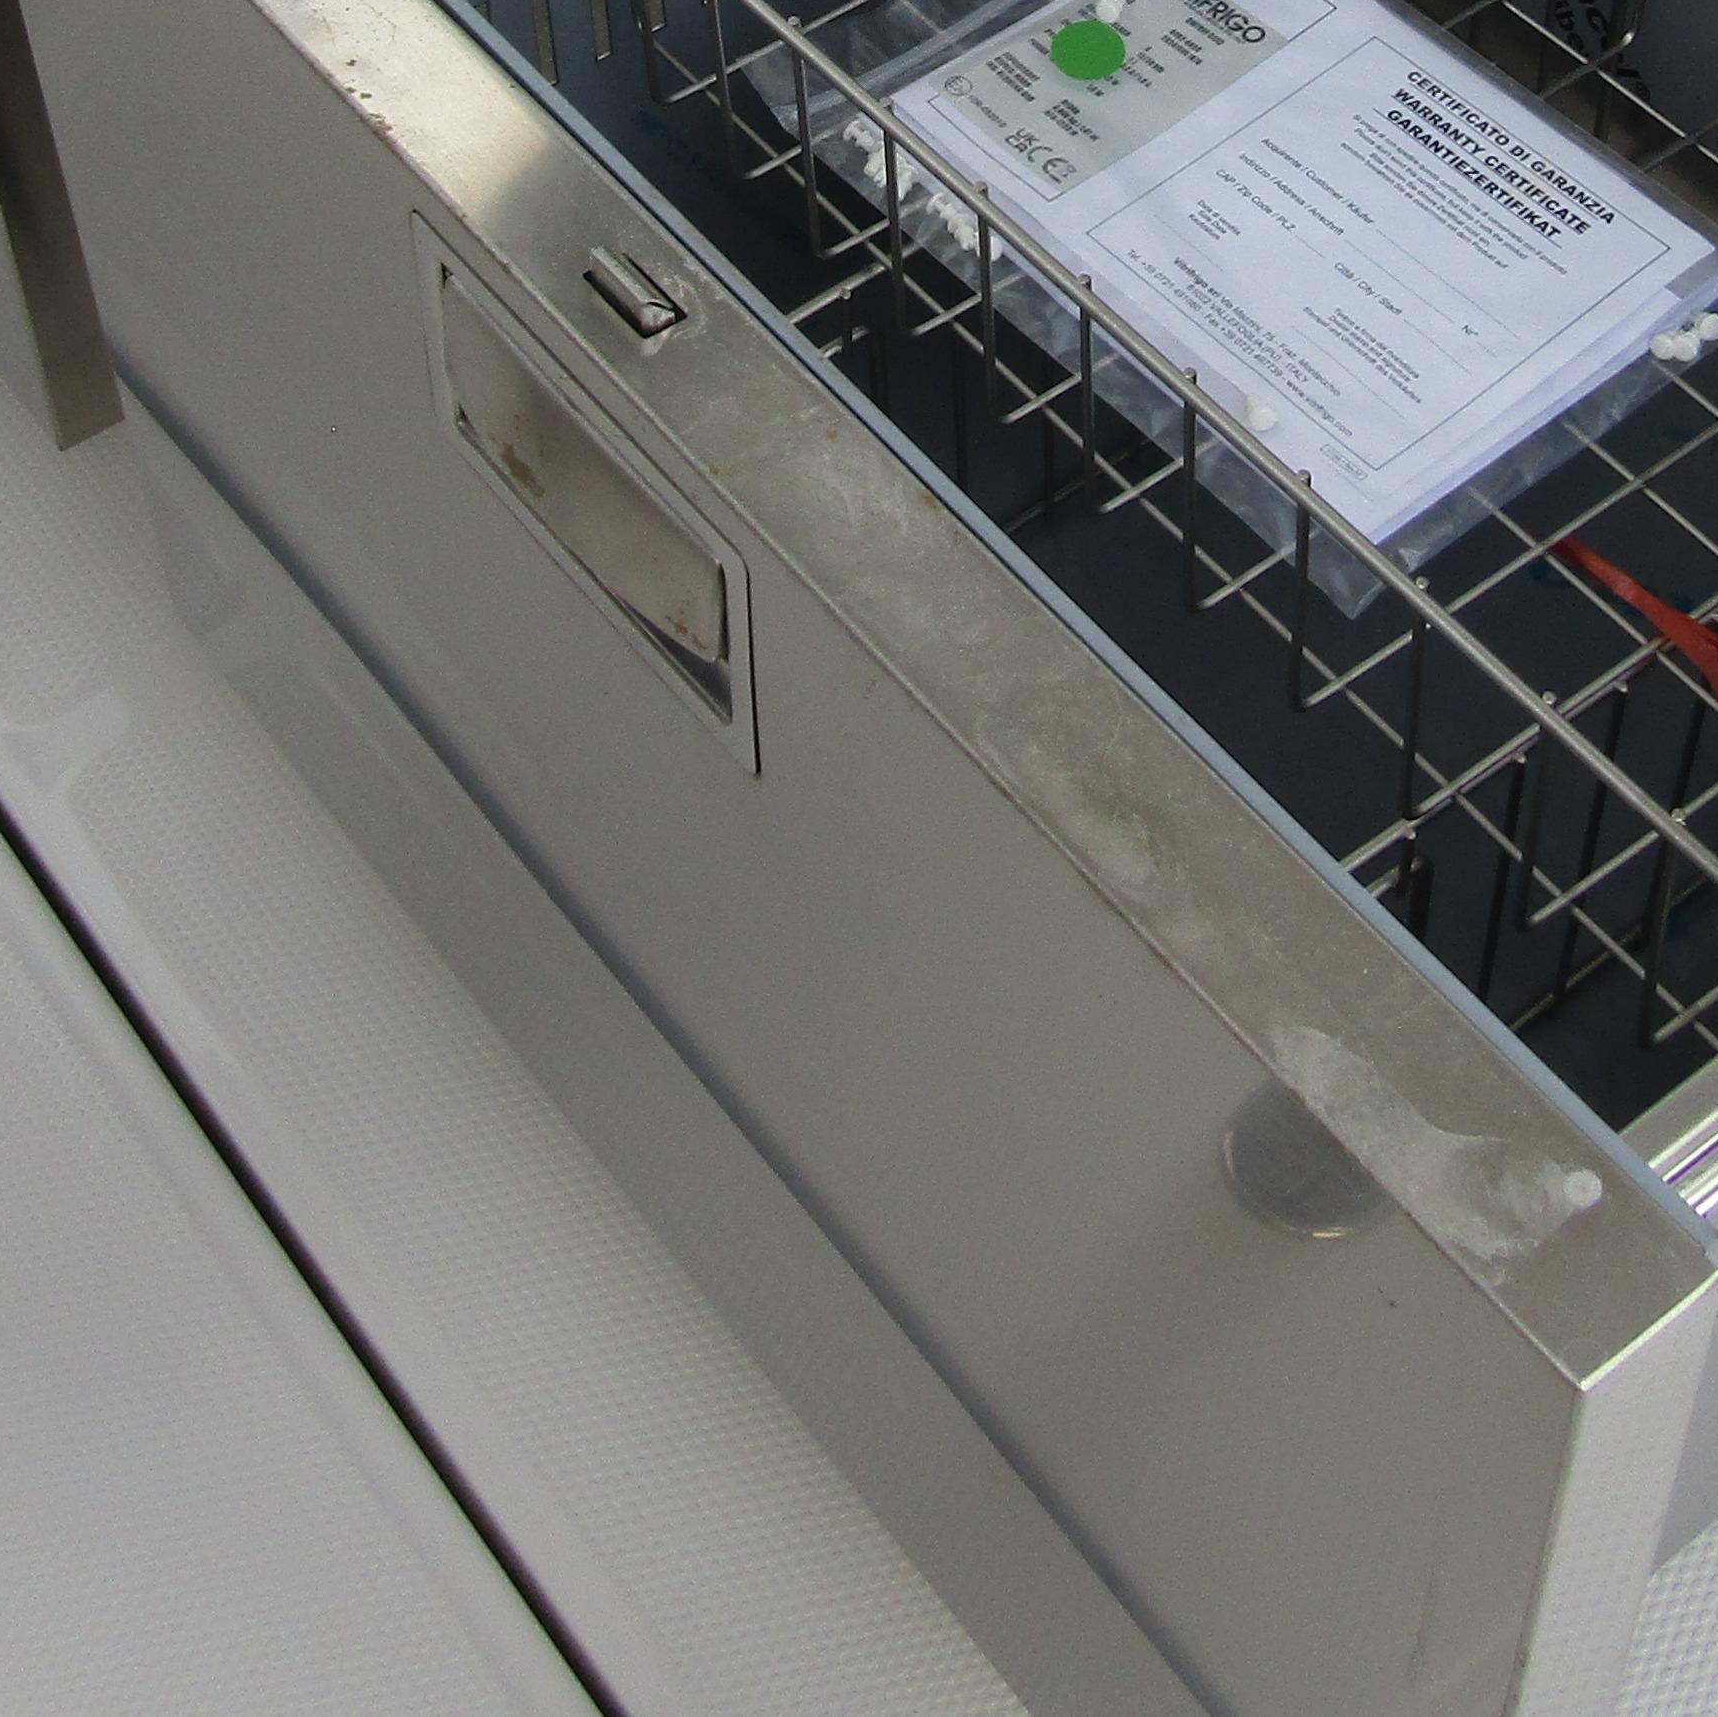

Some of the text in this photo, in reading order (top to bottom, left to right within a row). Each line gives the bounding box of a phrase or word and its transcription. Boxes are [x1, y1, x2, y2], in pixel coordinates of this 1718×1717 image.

[1257, 135, 1306, 172] Acquirente
[1303, 169, 1347, 202] Customer
[1383, 108, 1563, 240] GARANTIEZERTIFIKAT
[1390, 87, 1593, 235] WARRANTY CERTIFICATE
[1403, 69, 1619, 225] CERTIFICATO DI GARANZIA
[1213, 167, 1238, 185] CAP
[1234, 184, 1256, 200] Zip
[1249, 194, 1277, 216] Code
[1275, 214, 1298, 232] PLZ
[1271, 178, 1309, 208] Address
[1306, 206, 1347, 237] Anschrift
[1168, 256, 1210, 289] Vitrifrigo
[1203, 283, 1222, 297] srl
[1215, 292, 1235, 308] Via
[1352, 278, 1378, 298] City
[1375, 294, 1404, 317] Stadt
[1281, 362, 1310, 385] ITALY
